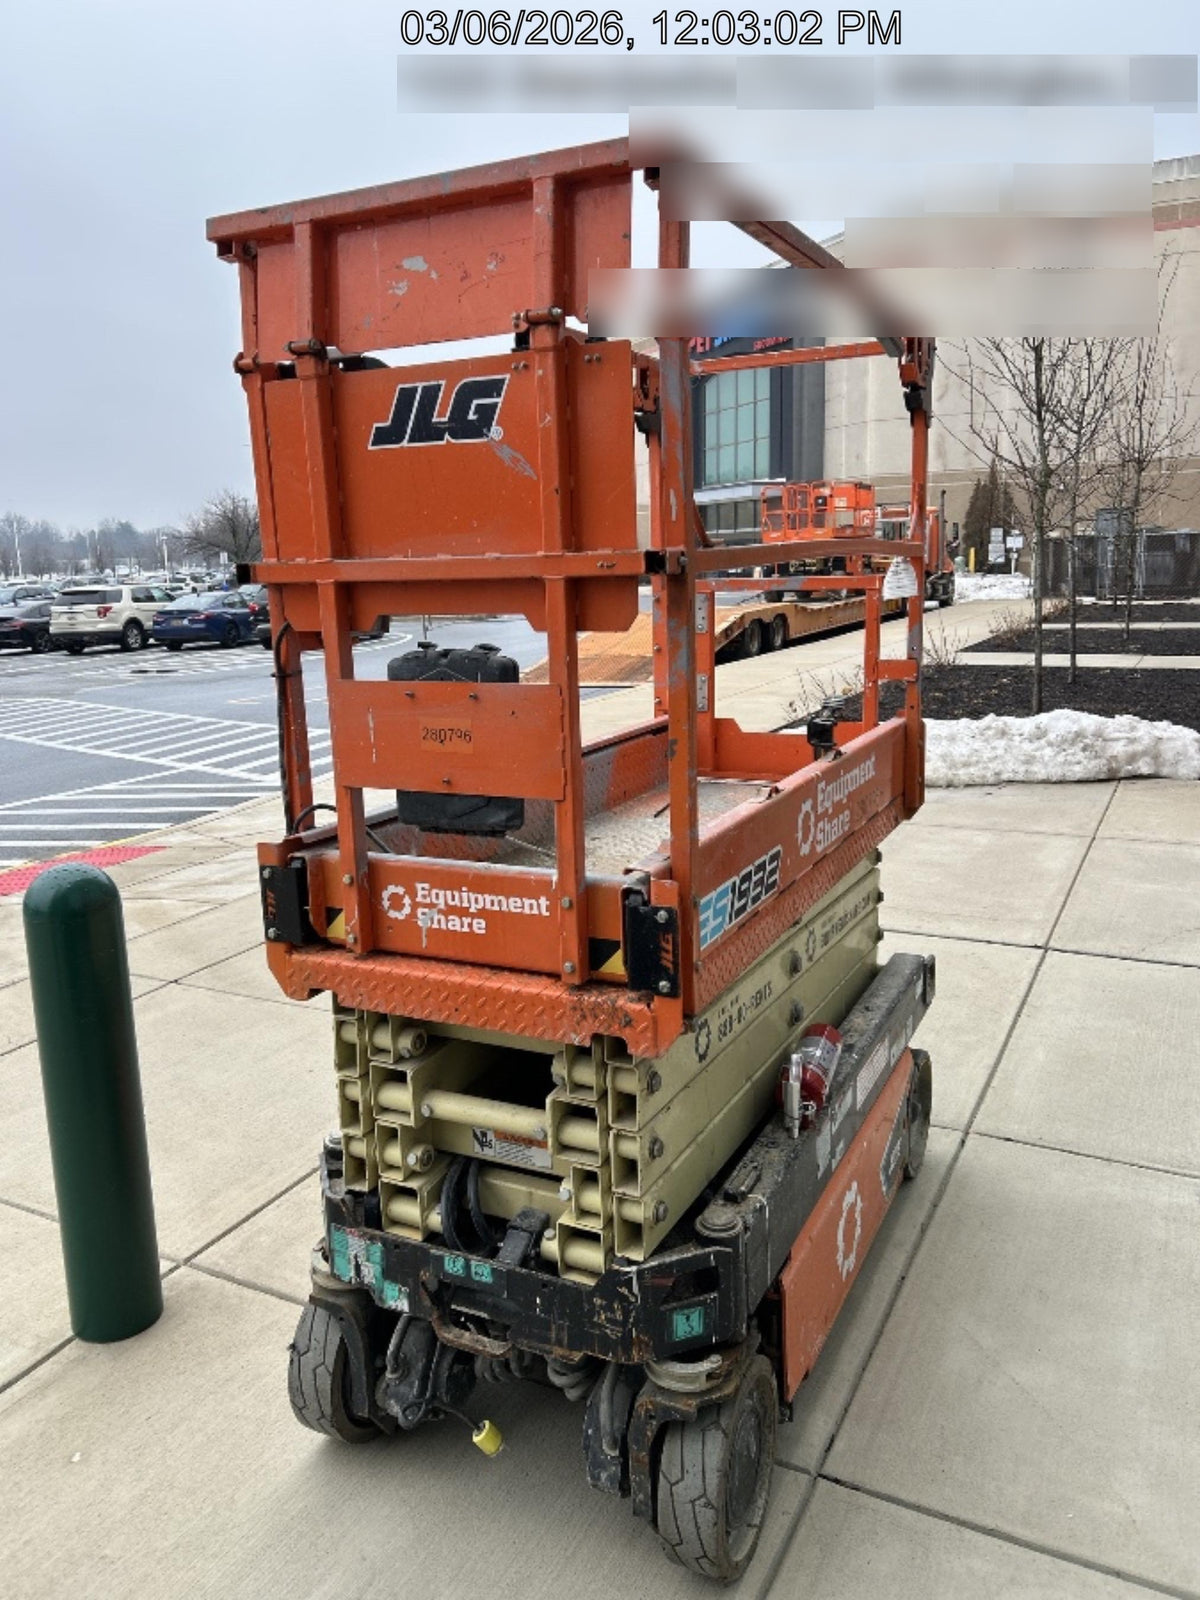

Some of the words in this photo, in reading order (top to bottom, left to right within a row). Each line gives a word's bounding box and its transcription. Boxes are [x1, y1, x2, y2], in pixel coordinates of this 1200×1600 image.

[367, 373, 511, 450] JLG
[422, 726, 472, 743] 280796
[816, 755, 876, 815] Equipment
[814, 808, 850, 853] Share
[414, 881, 551, 917] Equipment
[700, 844, 782, 951] ES1932
[416, 907, 487, 934] Share
